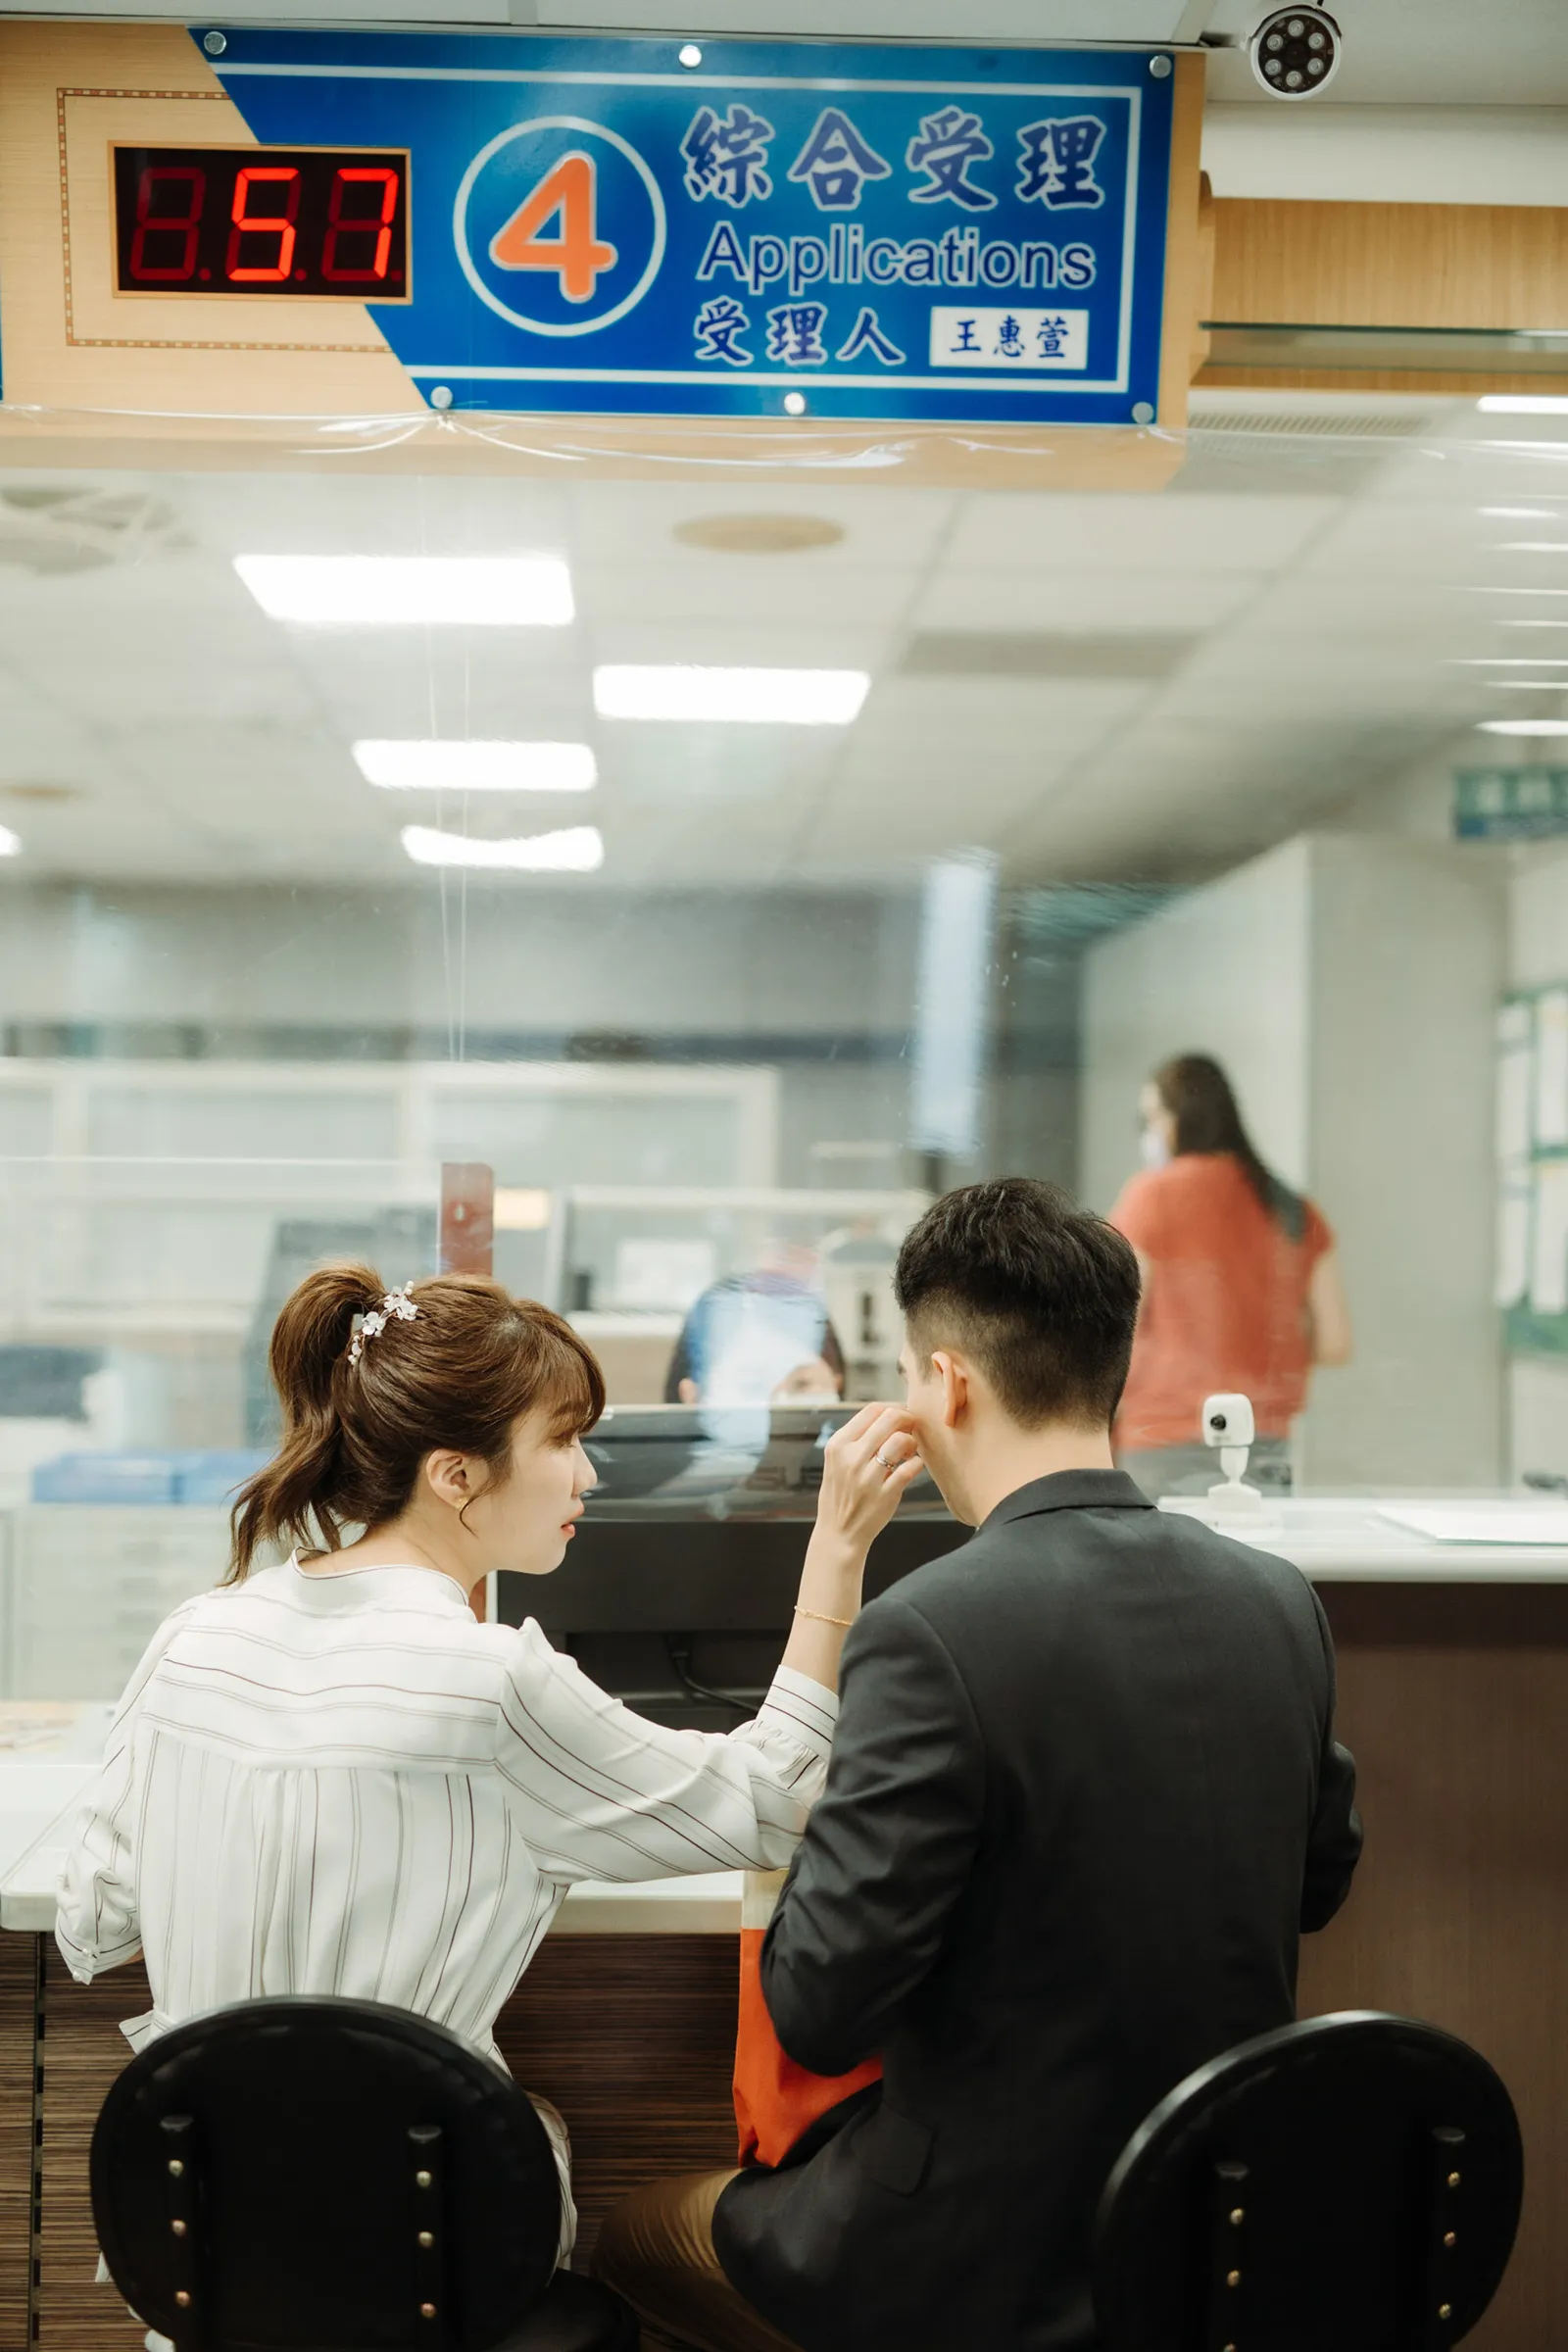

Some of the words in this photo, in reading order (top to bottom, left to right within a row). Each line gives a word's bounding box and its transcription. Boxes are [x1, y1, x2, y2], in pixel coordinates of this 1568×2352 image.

[679, 103, 1107, 212] 綜合受理
[227, 168, 399, 281] 57
[490, 150, 618, 304] 4
[696, 220, 1097, 296] Applications
[694, 295, 906, 367] 受理人
[949, 314, 1070, 360] 王惠萱
